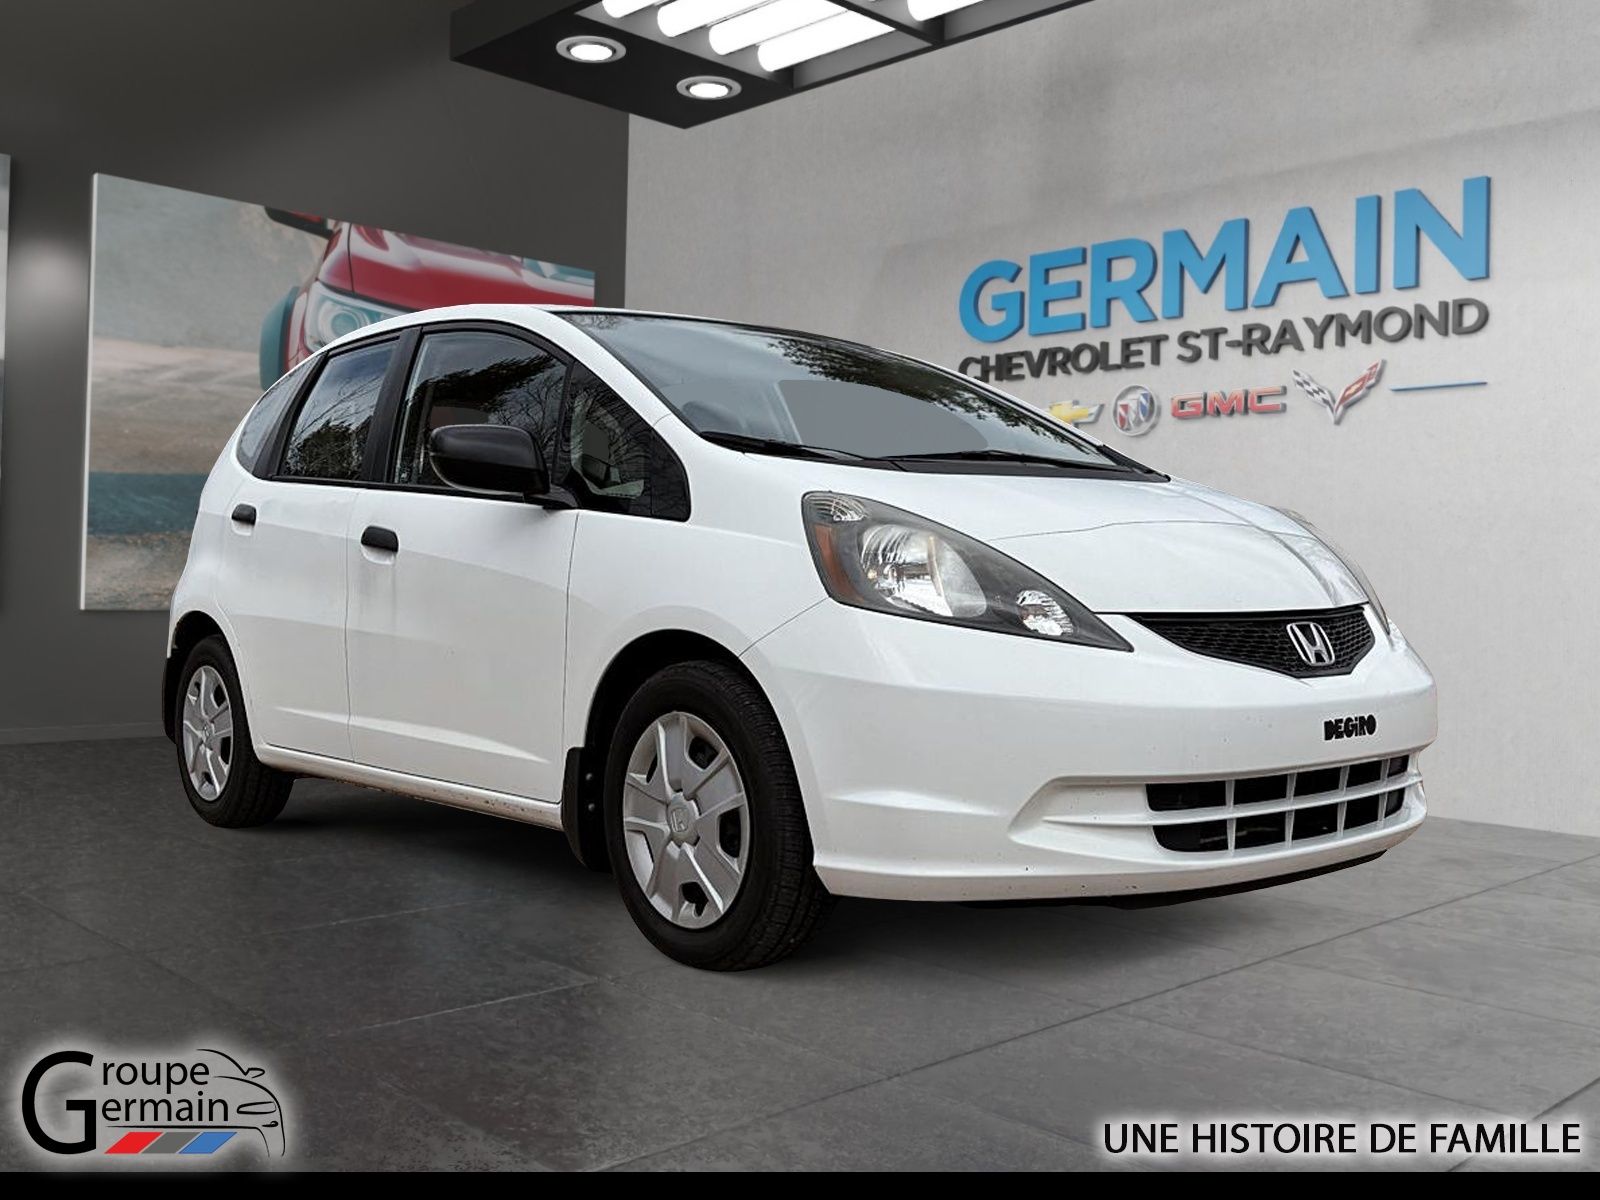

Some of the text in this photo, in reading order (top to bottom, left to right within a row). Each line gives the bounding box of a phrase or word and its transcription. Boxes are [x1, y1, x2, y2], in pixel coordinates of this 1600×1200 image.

[958, 176, 1492, 344] GERMAIN
[958, 298, 1490, 383] CHEVROLET ST-RAYMOND
[1171, 385, 1287, 419] GMC
